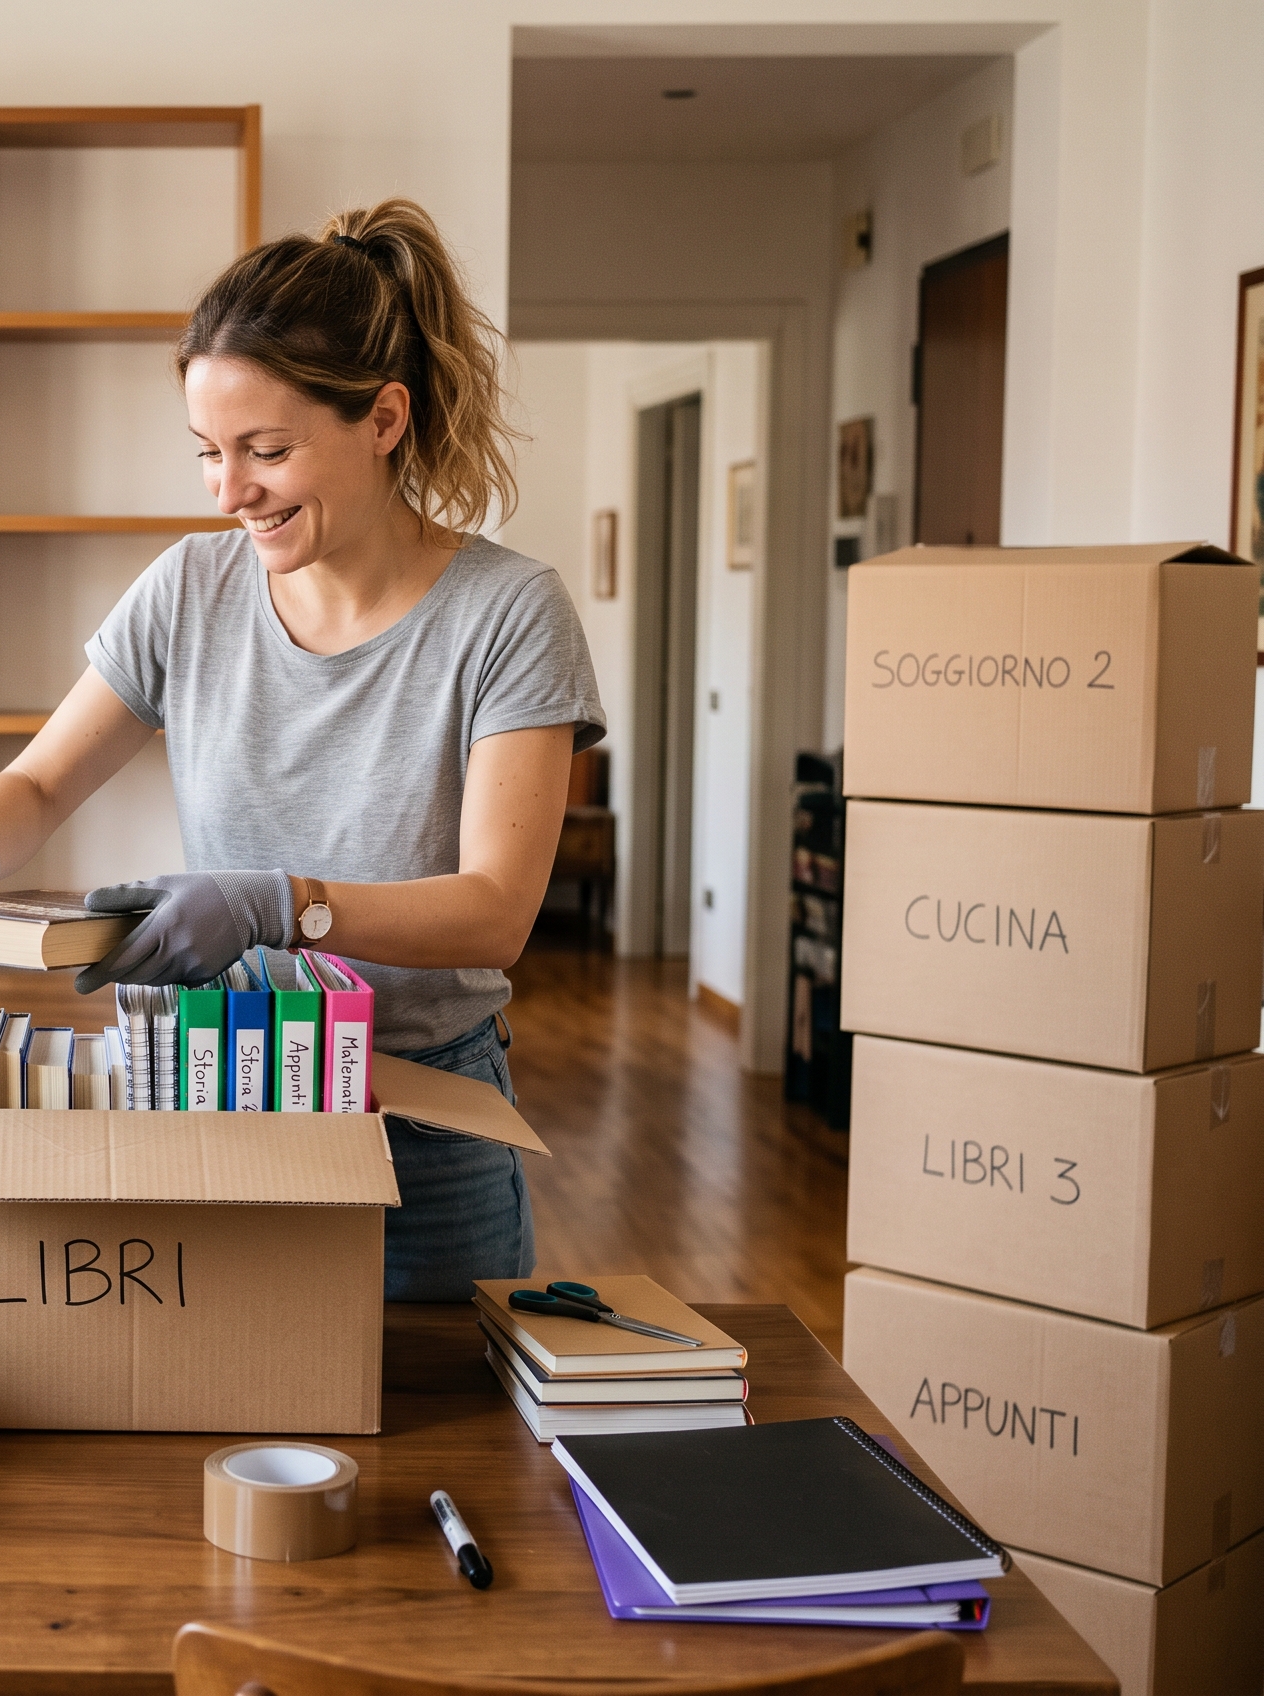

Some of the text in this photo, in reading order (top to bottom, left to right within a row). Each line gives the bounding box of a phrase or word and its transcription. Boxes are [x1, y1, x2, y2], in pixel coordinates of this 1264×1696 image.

[871, 649, 1115, 690] SOGGIORNO 2
[904, 894, 1069, 954] CUCINA
[193, 1050, 214, 1105] Storia
[241, 1045, 260, 1096] Storia
[284, 1040, 310, 1106] Appunti
[922, 1133, 1082, 1205] LIBRI 3
[909, 1377, 1079, 1457] APPUNTI
